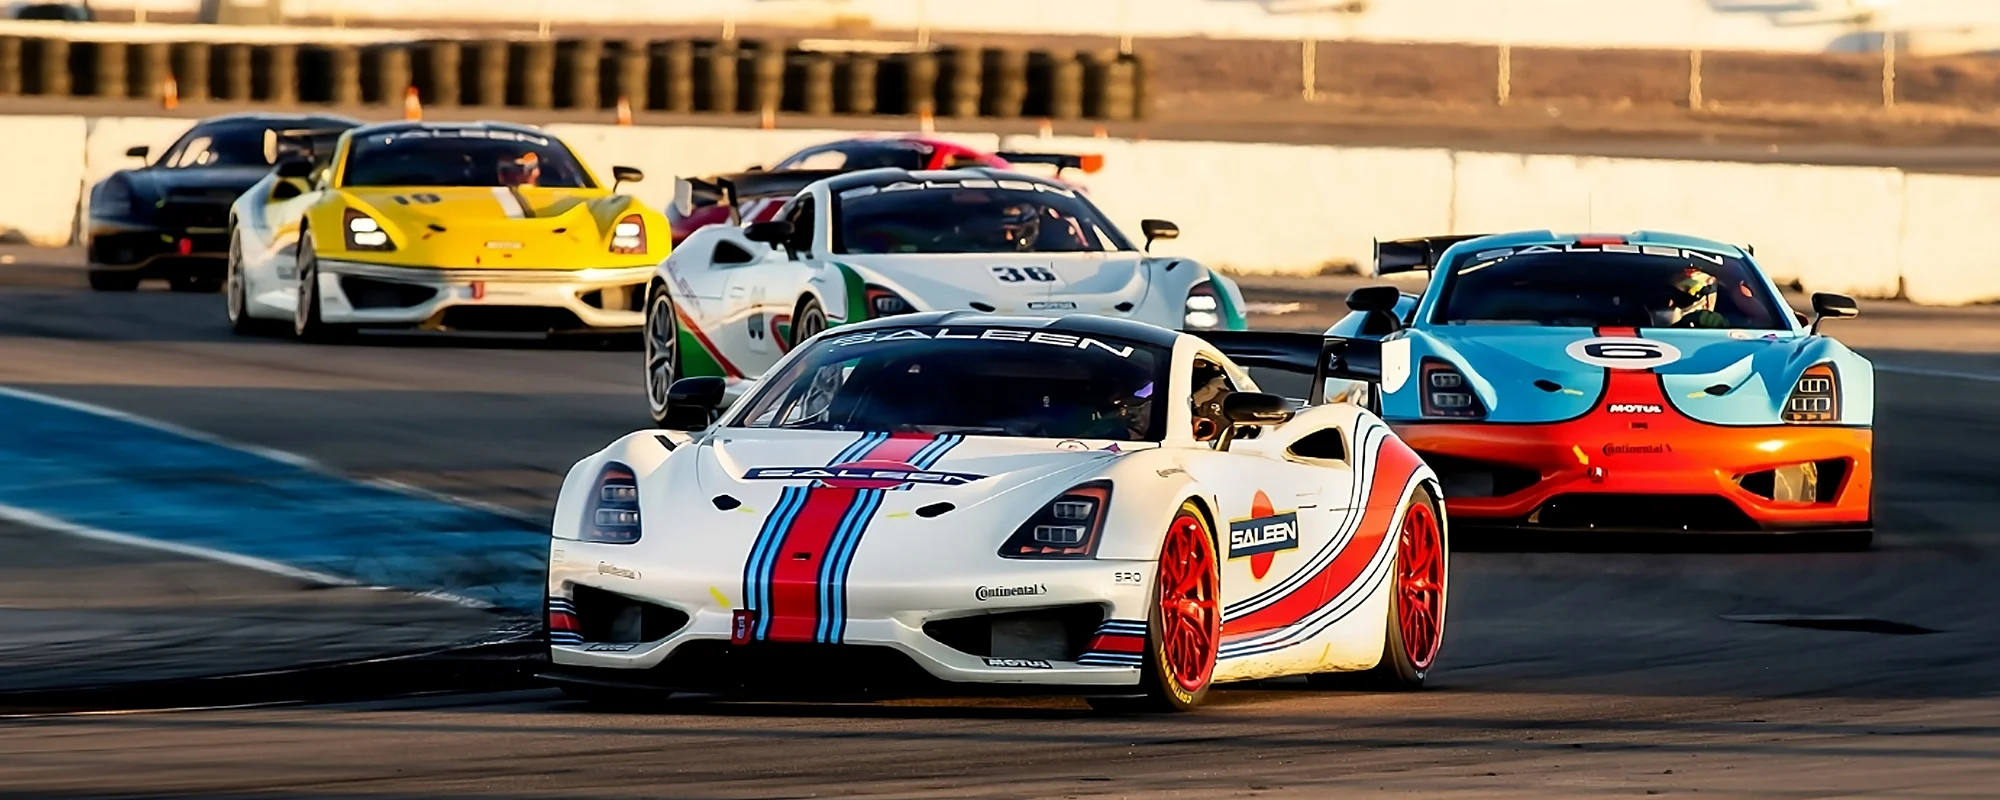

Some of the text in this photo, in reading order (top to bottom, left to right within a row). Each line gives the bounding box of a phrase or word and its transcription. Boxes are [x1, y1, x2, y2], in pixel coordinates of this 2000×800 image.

[831, 328, 1135, 358] SALEEN
[1584, 343, 1662, 359] 6
[1609, 404, 1662, 413] MOTUL
[1231, 520, 1297, 550] SALEEN
[1114, 572, 1142, 582] SRO
[975, 584, 1038, 601] Continental
[987, 659, 1050, 669] MOTUL
